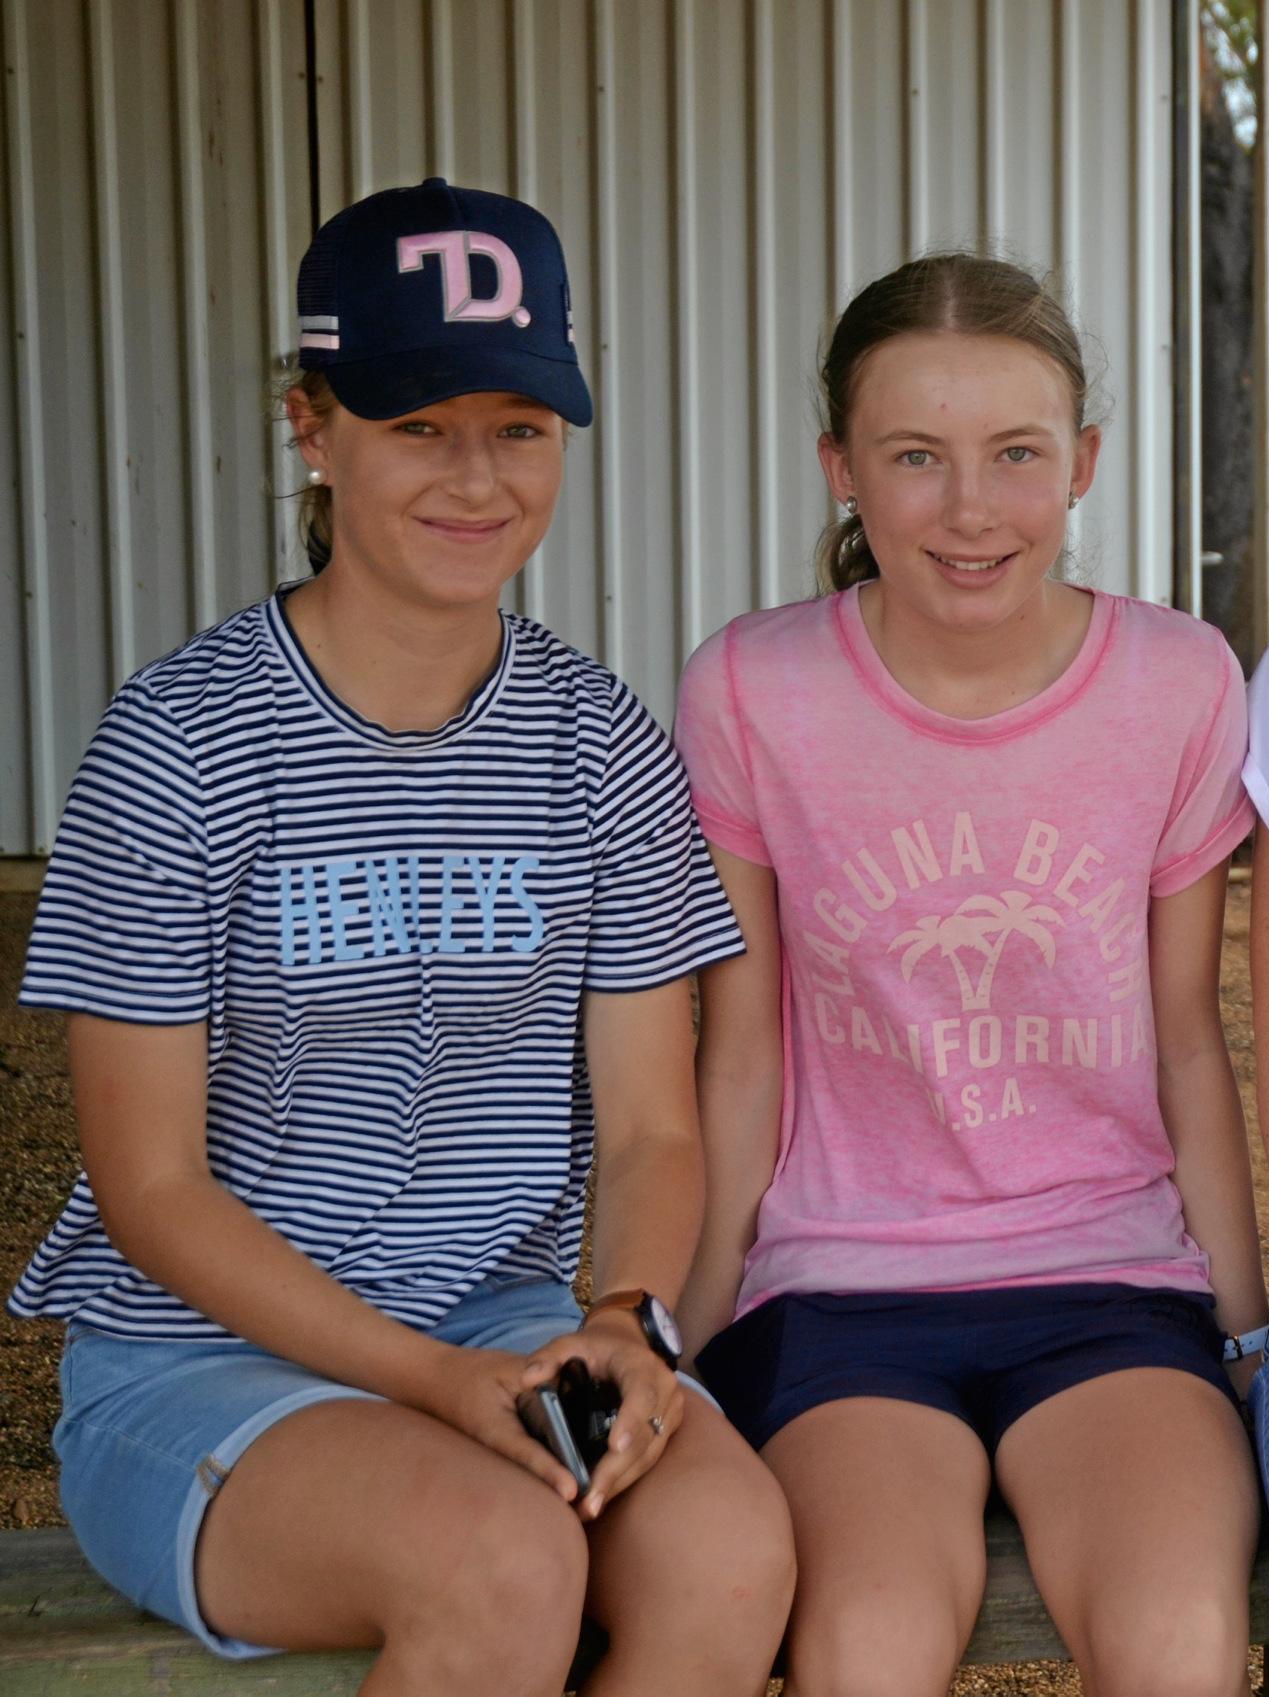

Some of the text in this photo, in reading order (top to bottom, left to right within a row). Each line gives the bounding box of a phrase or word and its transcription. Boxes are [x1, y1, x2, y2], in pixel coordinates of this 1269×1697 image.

[279, 855, 545, 967] HENLEYS
[803, 811, 1144, 1003] LAGUNA BEACH
[814, 991, 1152, 1079] CALIFORNIA
